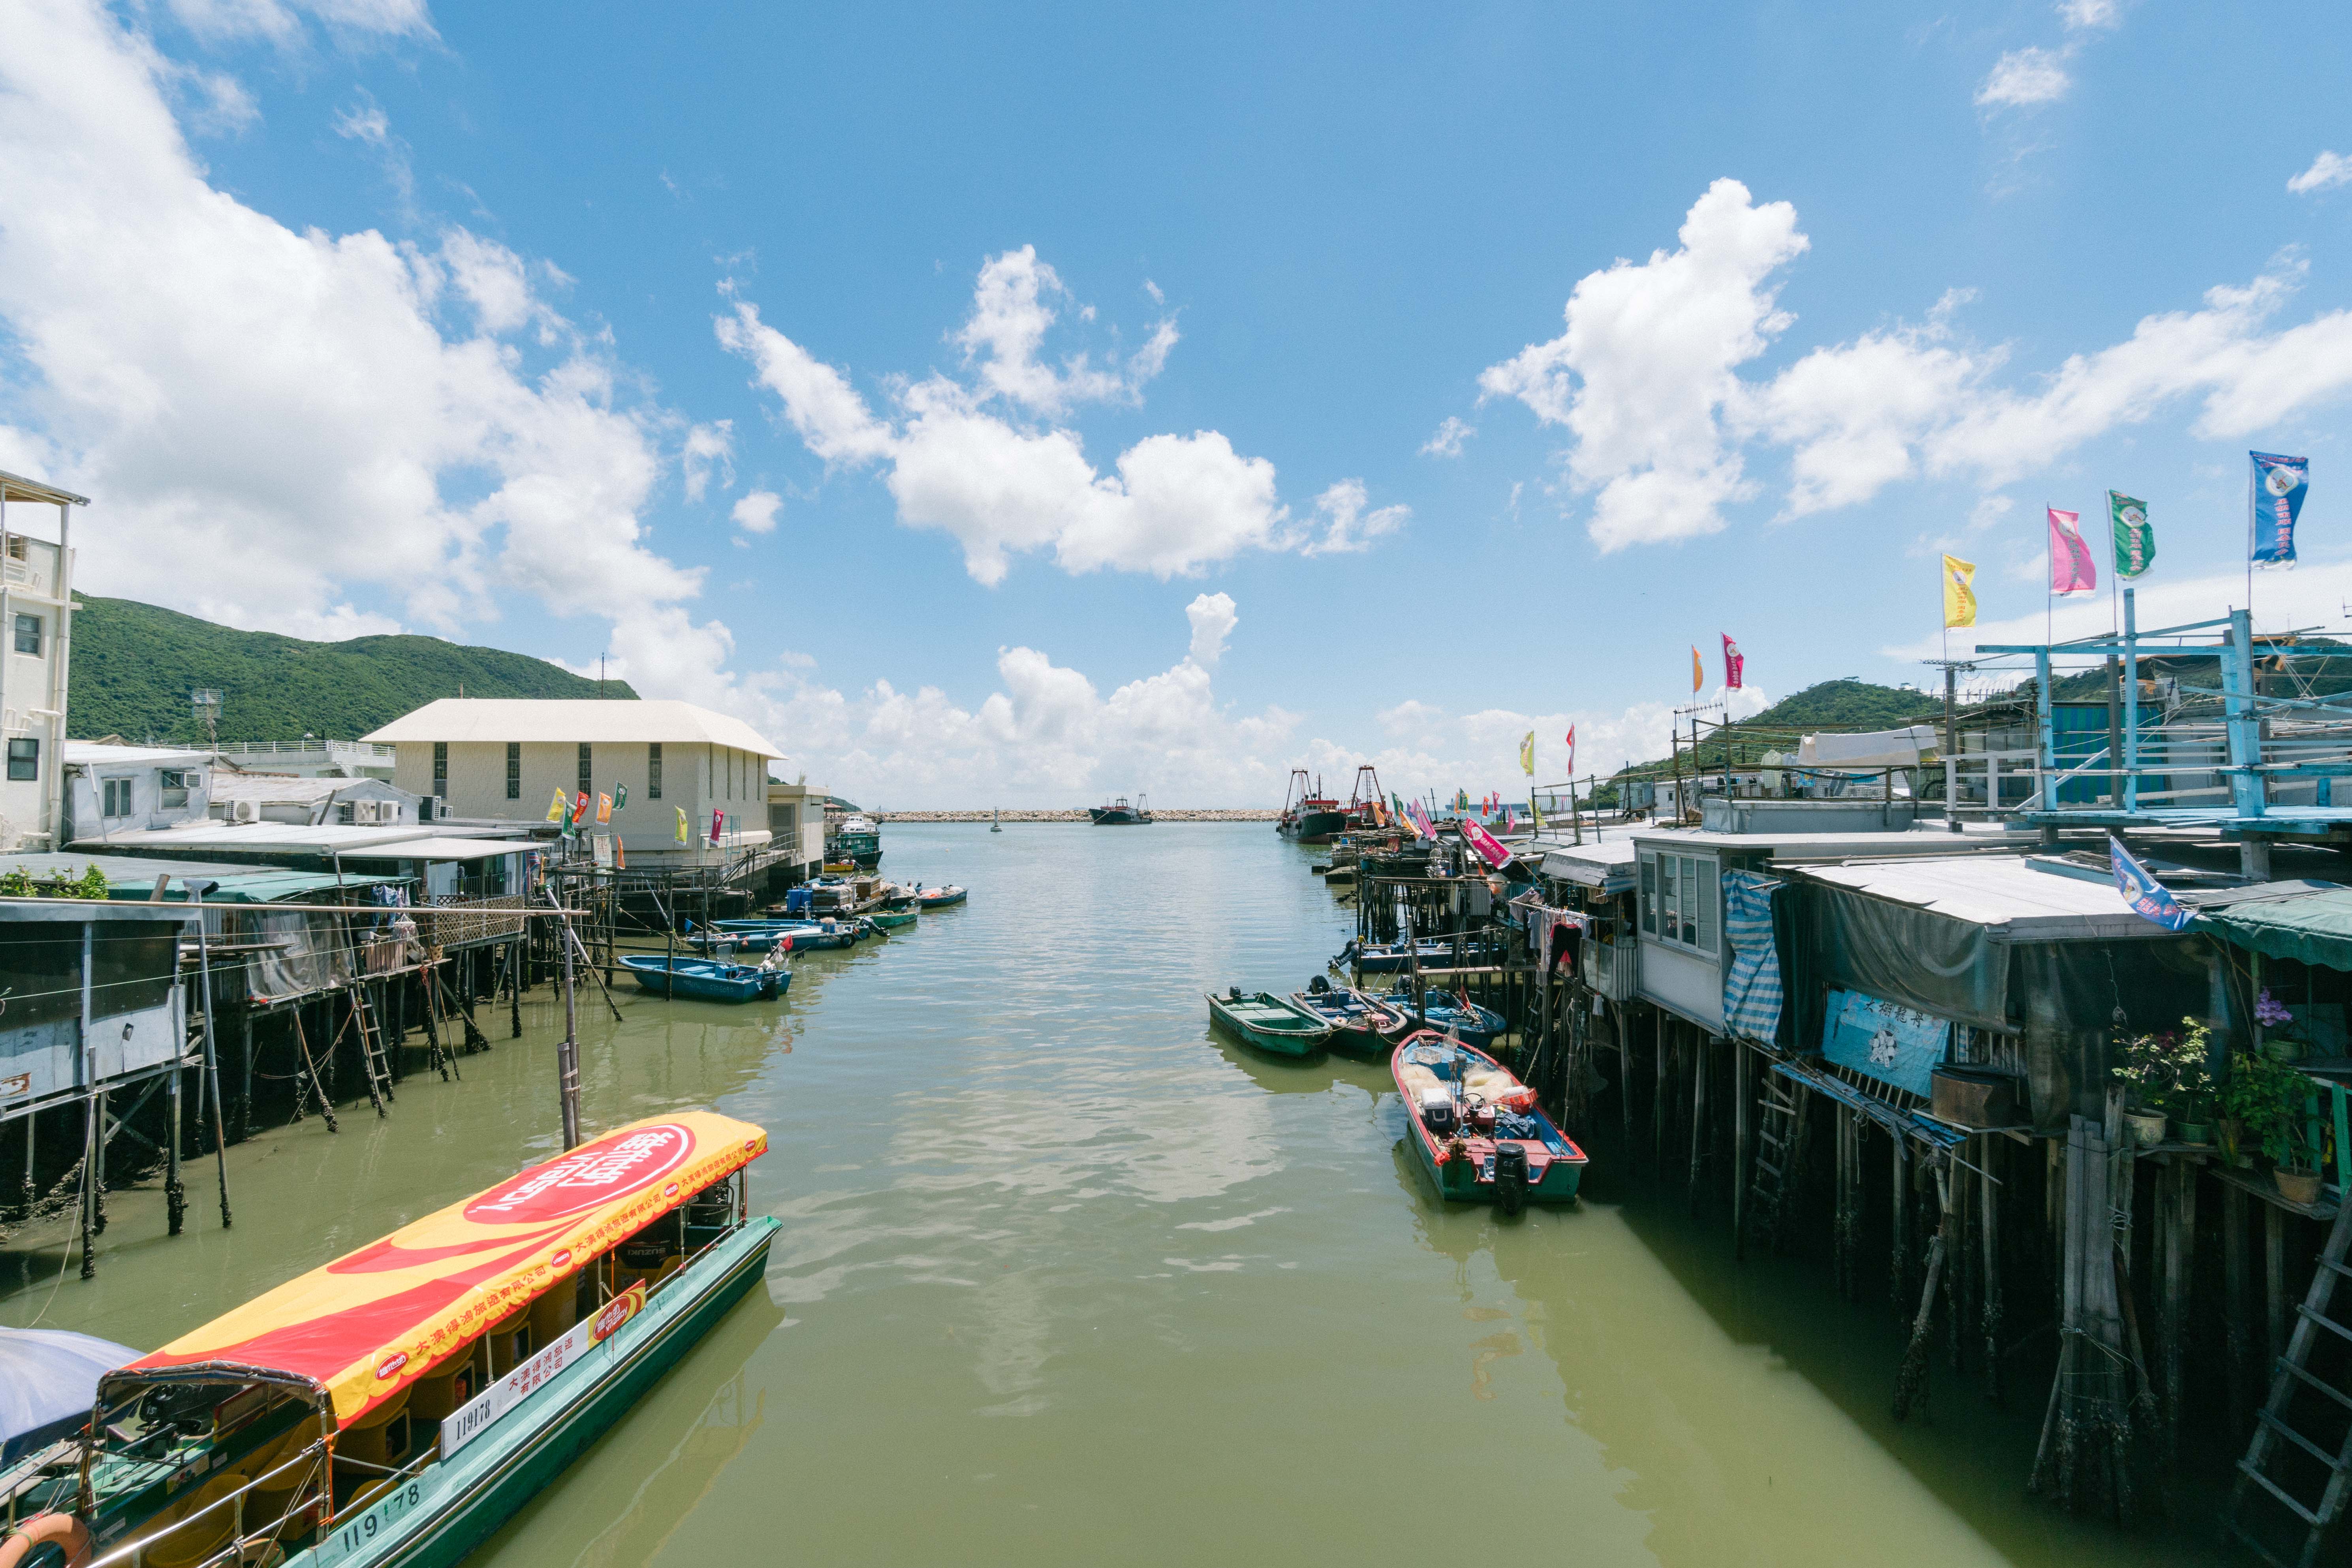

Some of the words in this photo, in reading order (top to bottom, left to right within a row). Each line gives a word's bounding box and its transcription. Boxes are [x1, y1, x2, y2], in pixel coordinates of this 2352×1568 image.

[557, 1132, 675, 1187] 維他奶
[521, 1357, 563, 1395] 有限公司
[456, 1399, 491, 1440] 119178
